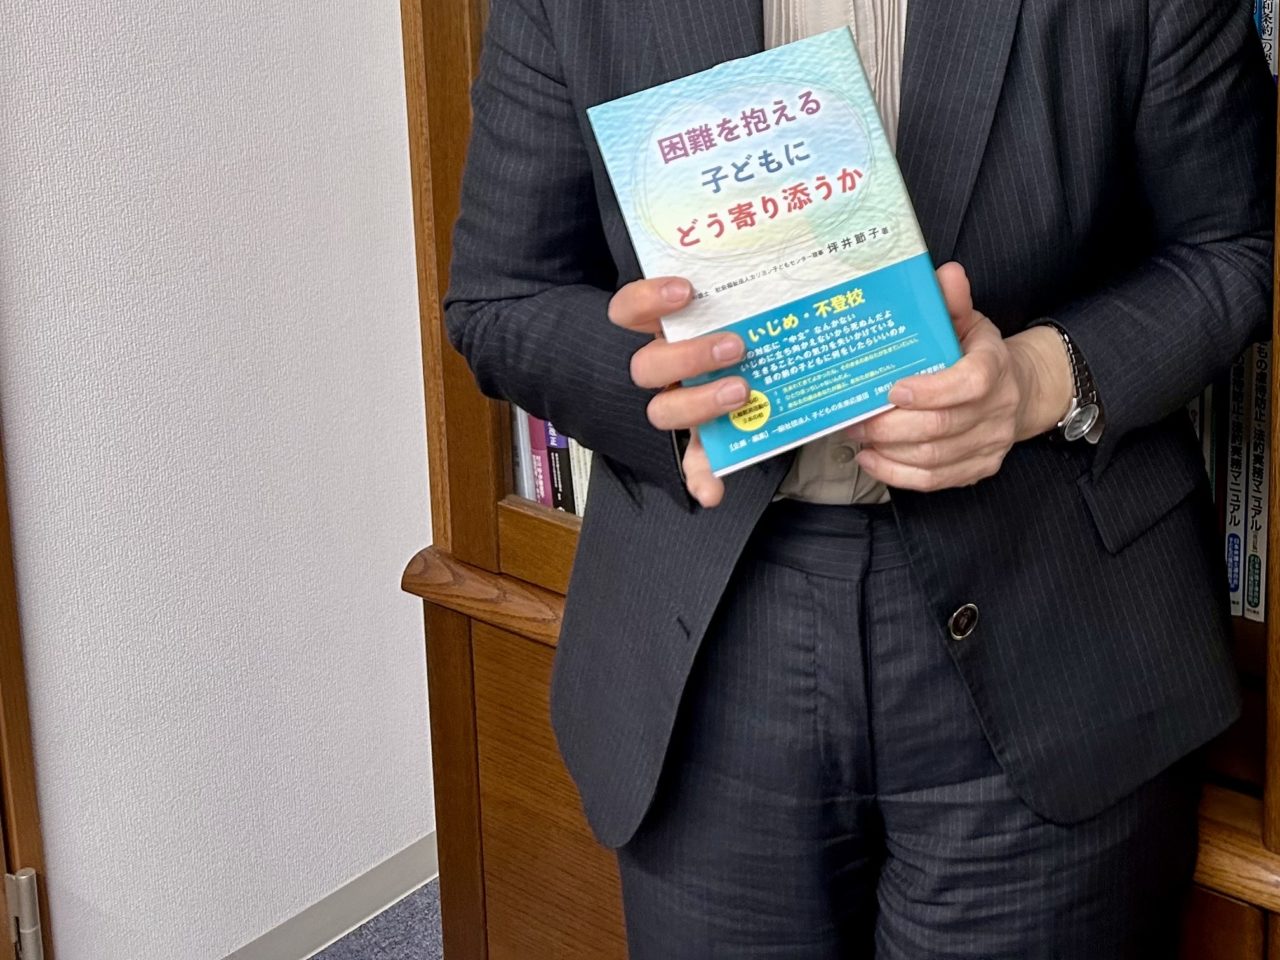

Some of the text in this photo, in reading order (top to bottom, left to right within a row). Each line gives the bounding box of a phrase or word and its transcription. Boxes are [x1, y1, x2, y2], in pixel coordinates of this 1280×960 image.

[657, 90, 821, 165] 困難を抱える
[701, 141, 811, 194] 子どもに
[676, 168, 863, 247] どう寄り添うか
[827, 227, 879, 254] 坪井節子
[748, 288, 866, 343] いじめ・不登校
[813, 313, 856, 335] なんかない
[752, 320, 895, 379] 生きることへの気力を失いかけている
[764, 326, 906, 385] 目の前の子どもに何をしたらいいのか
